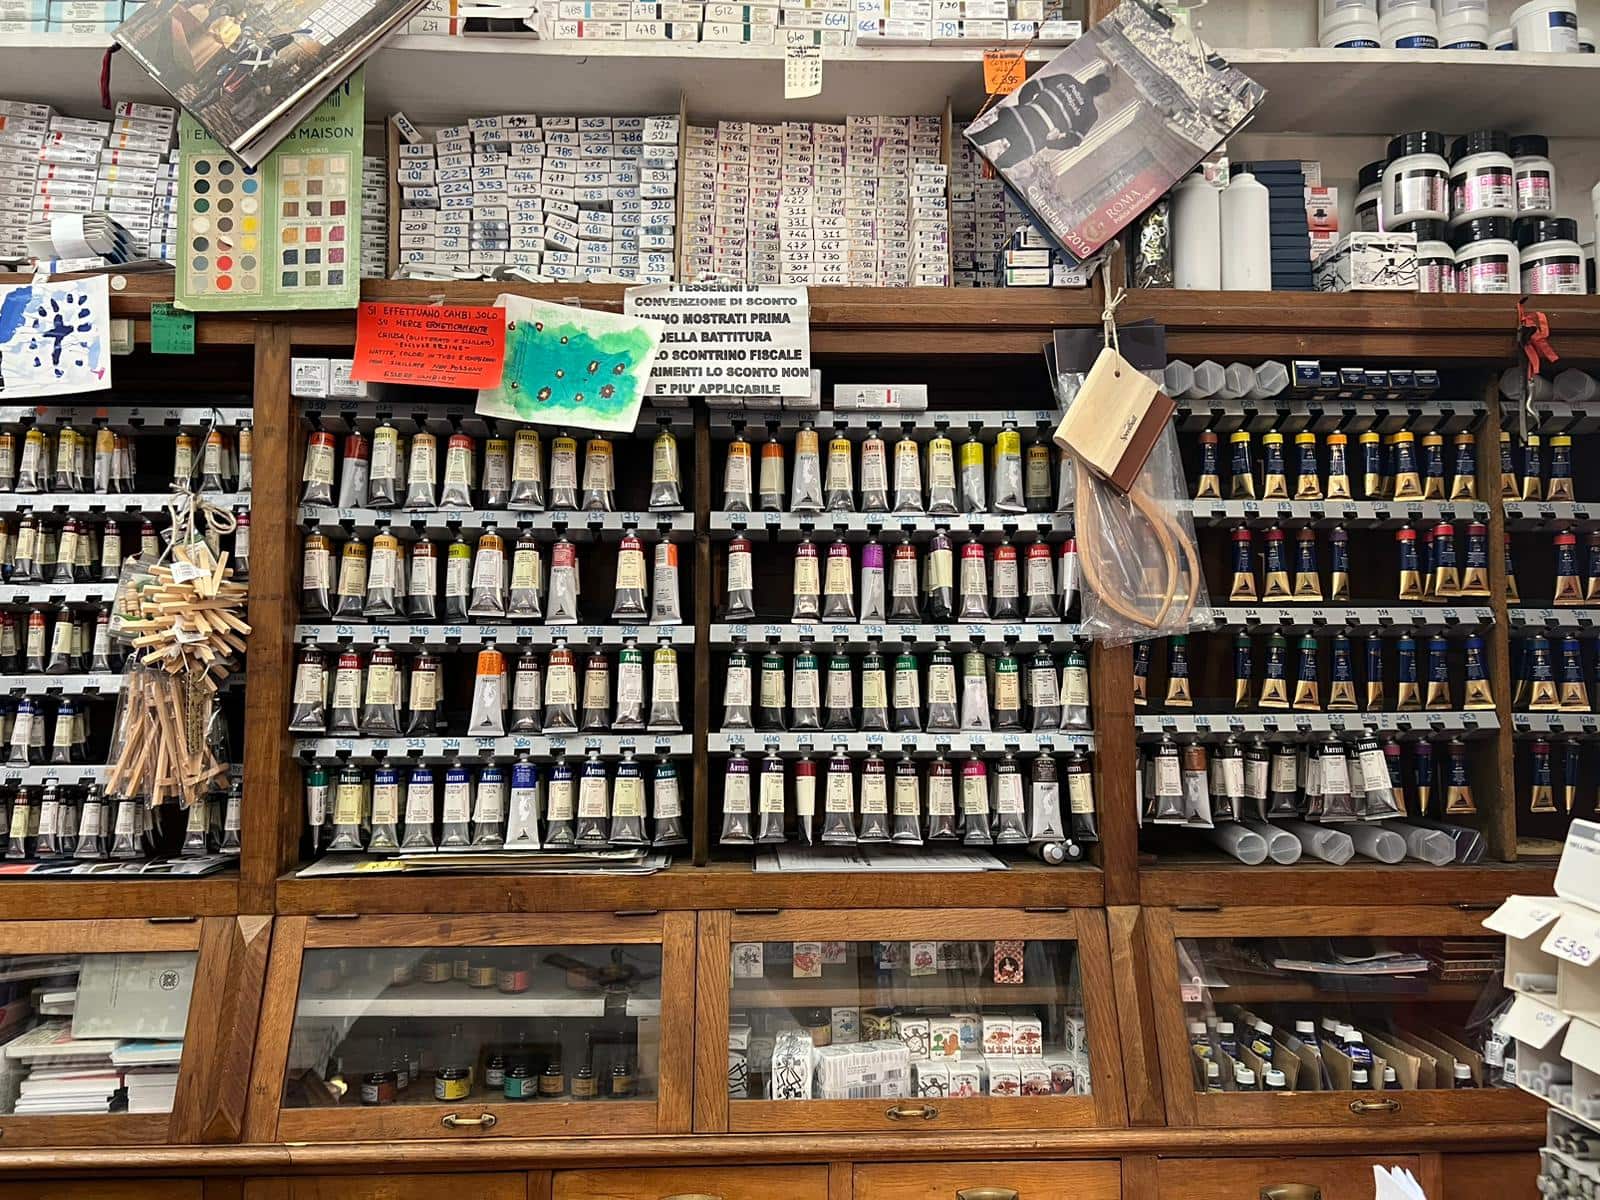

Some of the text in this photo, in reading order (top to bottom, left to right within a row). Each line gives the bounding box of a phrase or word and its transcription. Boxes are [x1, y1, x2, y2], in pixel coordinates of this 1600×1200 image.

[825, 13, 846, 26] 664
[1011, 23, 1033, 33] 780
[299, 127, 354, 139] MAISON
[407, 145, 424, 154] 101
[408, 171, 423, 180] 101
[441, 169, 468, 179] 223
[443, 182, 470, 193] 224
[477, 180, 502, 190] 353
[413, 188, 432, 197] 102
[446, 198, 473, 207] 225
[650, 200, 671, 209] 920
[1105, 189, 1141, 220] ROMA
[788, 218, 808, 227] 331
[1027, 185, 1091, 255] Calendario 2010
[405, 223, 428, 231] 208
[821, 241, 839, 249] 667
[788, 253, 809, 261] 137
[821, 252, 840, 260] 730
[788, 275, 808, 283] 304
[822, 275, 841, 283] 644
[634, 297, 798, 306] CONVENZIONE DI SCONTO
[367, 305, 498, 320] SI EFFETTUANO CAMBI SOLO
[683, 313, 747, 324] MOSTRATI
[750, 313, 791, 324] PRIMA
[396, 319, 422, 329] MERCE
[701, 332, 772, 343] BATTITURA
[672, 350, 747, 361] SCONTRINO
[750, 350, 802, 360] FISCALE
[650, 367, 809, 378] RIMENTI LO SCONTO NON
[655, 384, 781, 394] E' PIU' APPLICABILE
